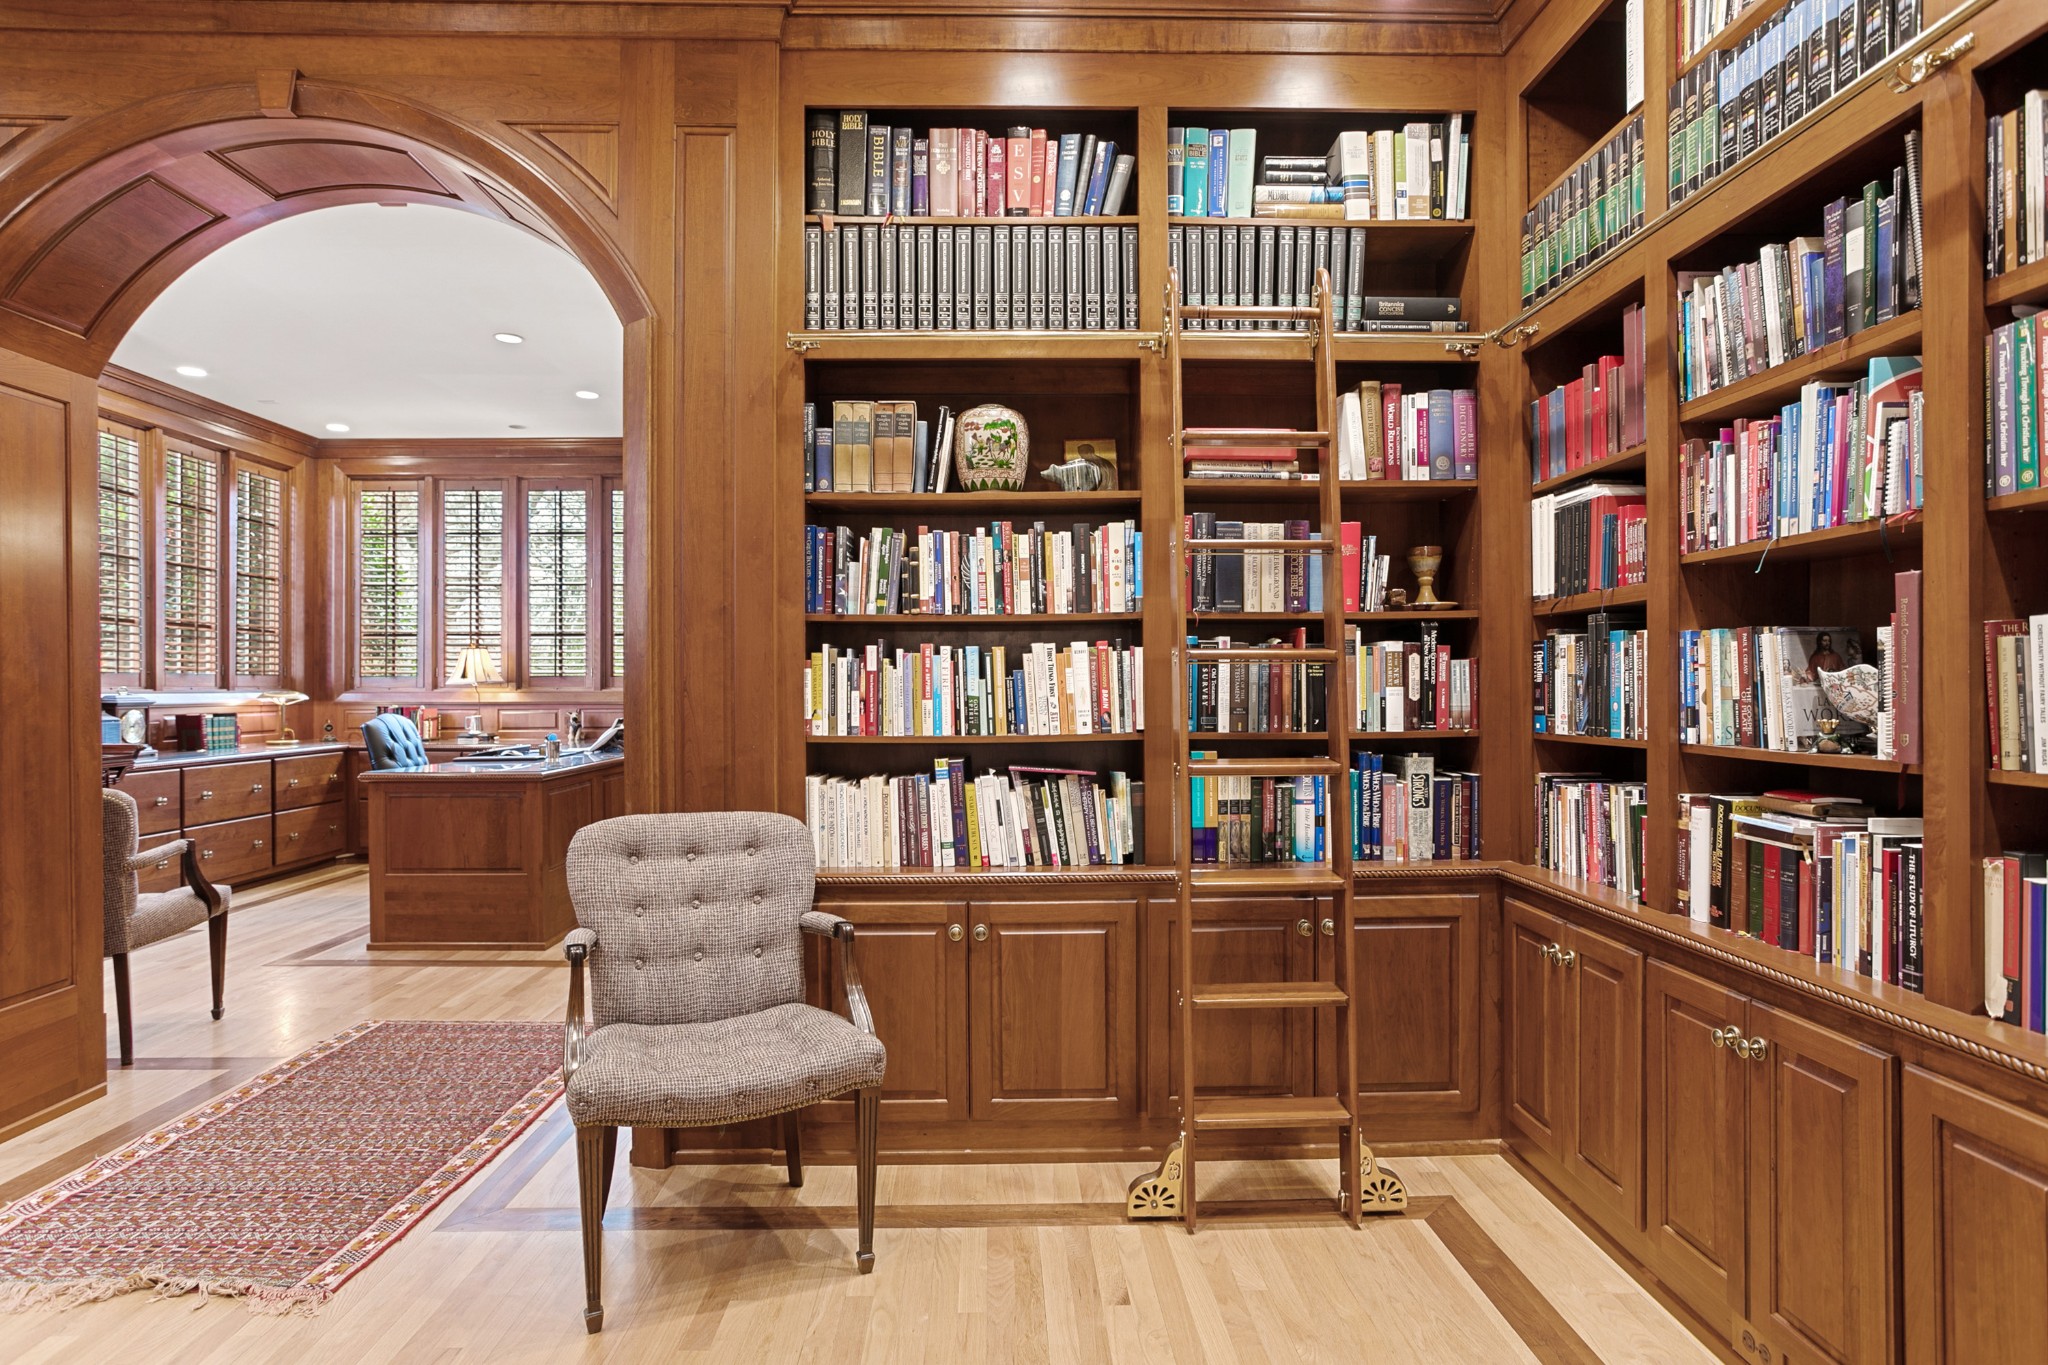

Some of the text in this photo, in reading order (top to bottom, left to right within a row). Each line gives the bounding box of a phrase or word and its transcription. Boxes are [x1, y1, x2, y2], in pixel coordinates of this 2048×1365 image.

[842, 122, 863, 130] BIBLE
[843, 114, 863, 123] HOLY
[811, 129, 836, 139] HOLY
[811, 138, 836, 148] BIBLE
[873, 135, 885, 178] BIBLE
[977, 168, 985, 193] ENGLISH
[1864, 191, 1873, 298] Women's Uncommon Prayers
[1728, 272, 1739, 313] KNOWING
[1731, 313, 1741, 333] GOD
[1723, 335, 1731, 355] GOD'S
[1735, 332, 1744, 362] PACKER
[1725, 356, 1733, 380] ACTION
[1998, 350, 2007, 384] Preaching
[1997, 384, 2007, 410] Through
[2019, 343, 2030, 462] Preaching Through the Christian Year
[1366, 397, 1375, 457] WORLD RELIGIONS
[2000, 410, 2008, 421] the
[1387, 402, 1396, 465] WORLD RELIGIONS
[1459, 405, 1467, 458] DICTIONARY
[1860, 431, 1866, 439] TO
[2000, 422, 2008, 452] Christian
[2000, 453, 2008, 467] Year
[1290, 574, 1298, 597] BIBLE
[1298, 577, 1304, 586] ON
[2002, 624, 2015, 633] THE
[942, 649, 949, 664] ON
[1900, 598, 1909, 705] Revised Common Lectionary
[1536, 650, 1544, 683] Christian
[1741, 691, 1747, 702] OF
[1786, 712, 1794, 737] WORD
[939, 783, 948, 818] Psychological
[1412, 775, 1425, 807] STRONG'S
[919, 798, 927, 813] DRIVEN
[1087, 790, 1098, 846] COGNITIVE BEHAVIOR
[989, 821, 997, 842] LOGIC
[1908, 854, 1917, 959] THE STUDY OF LITURGY
